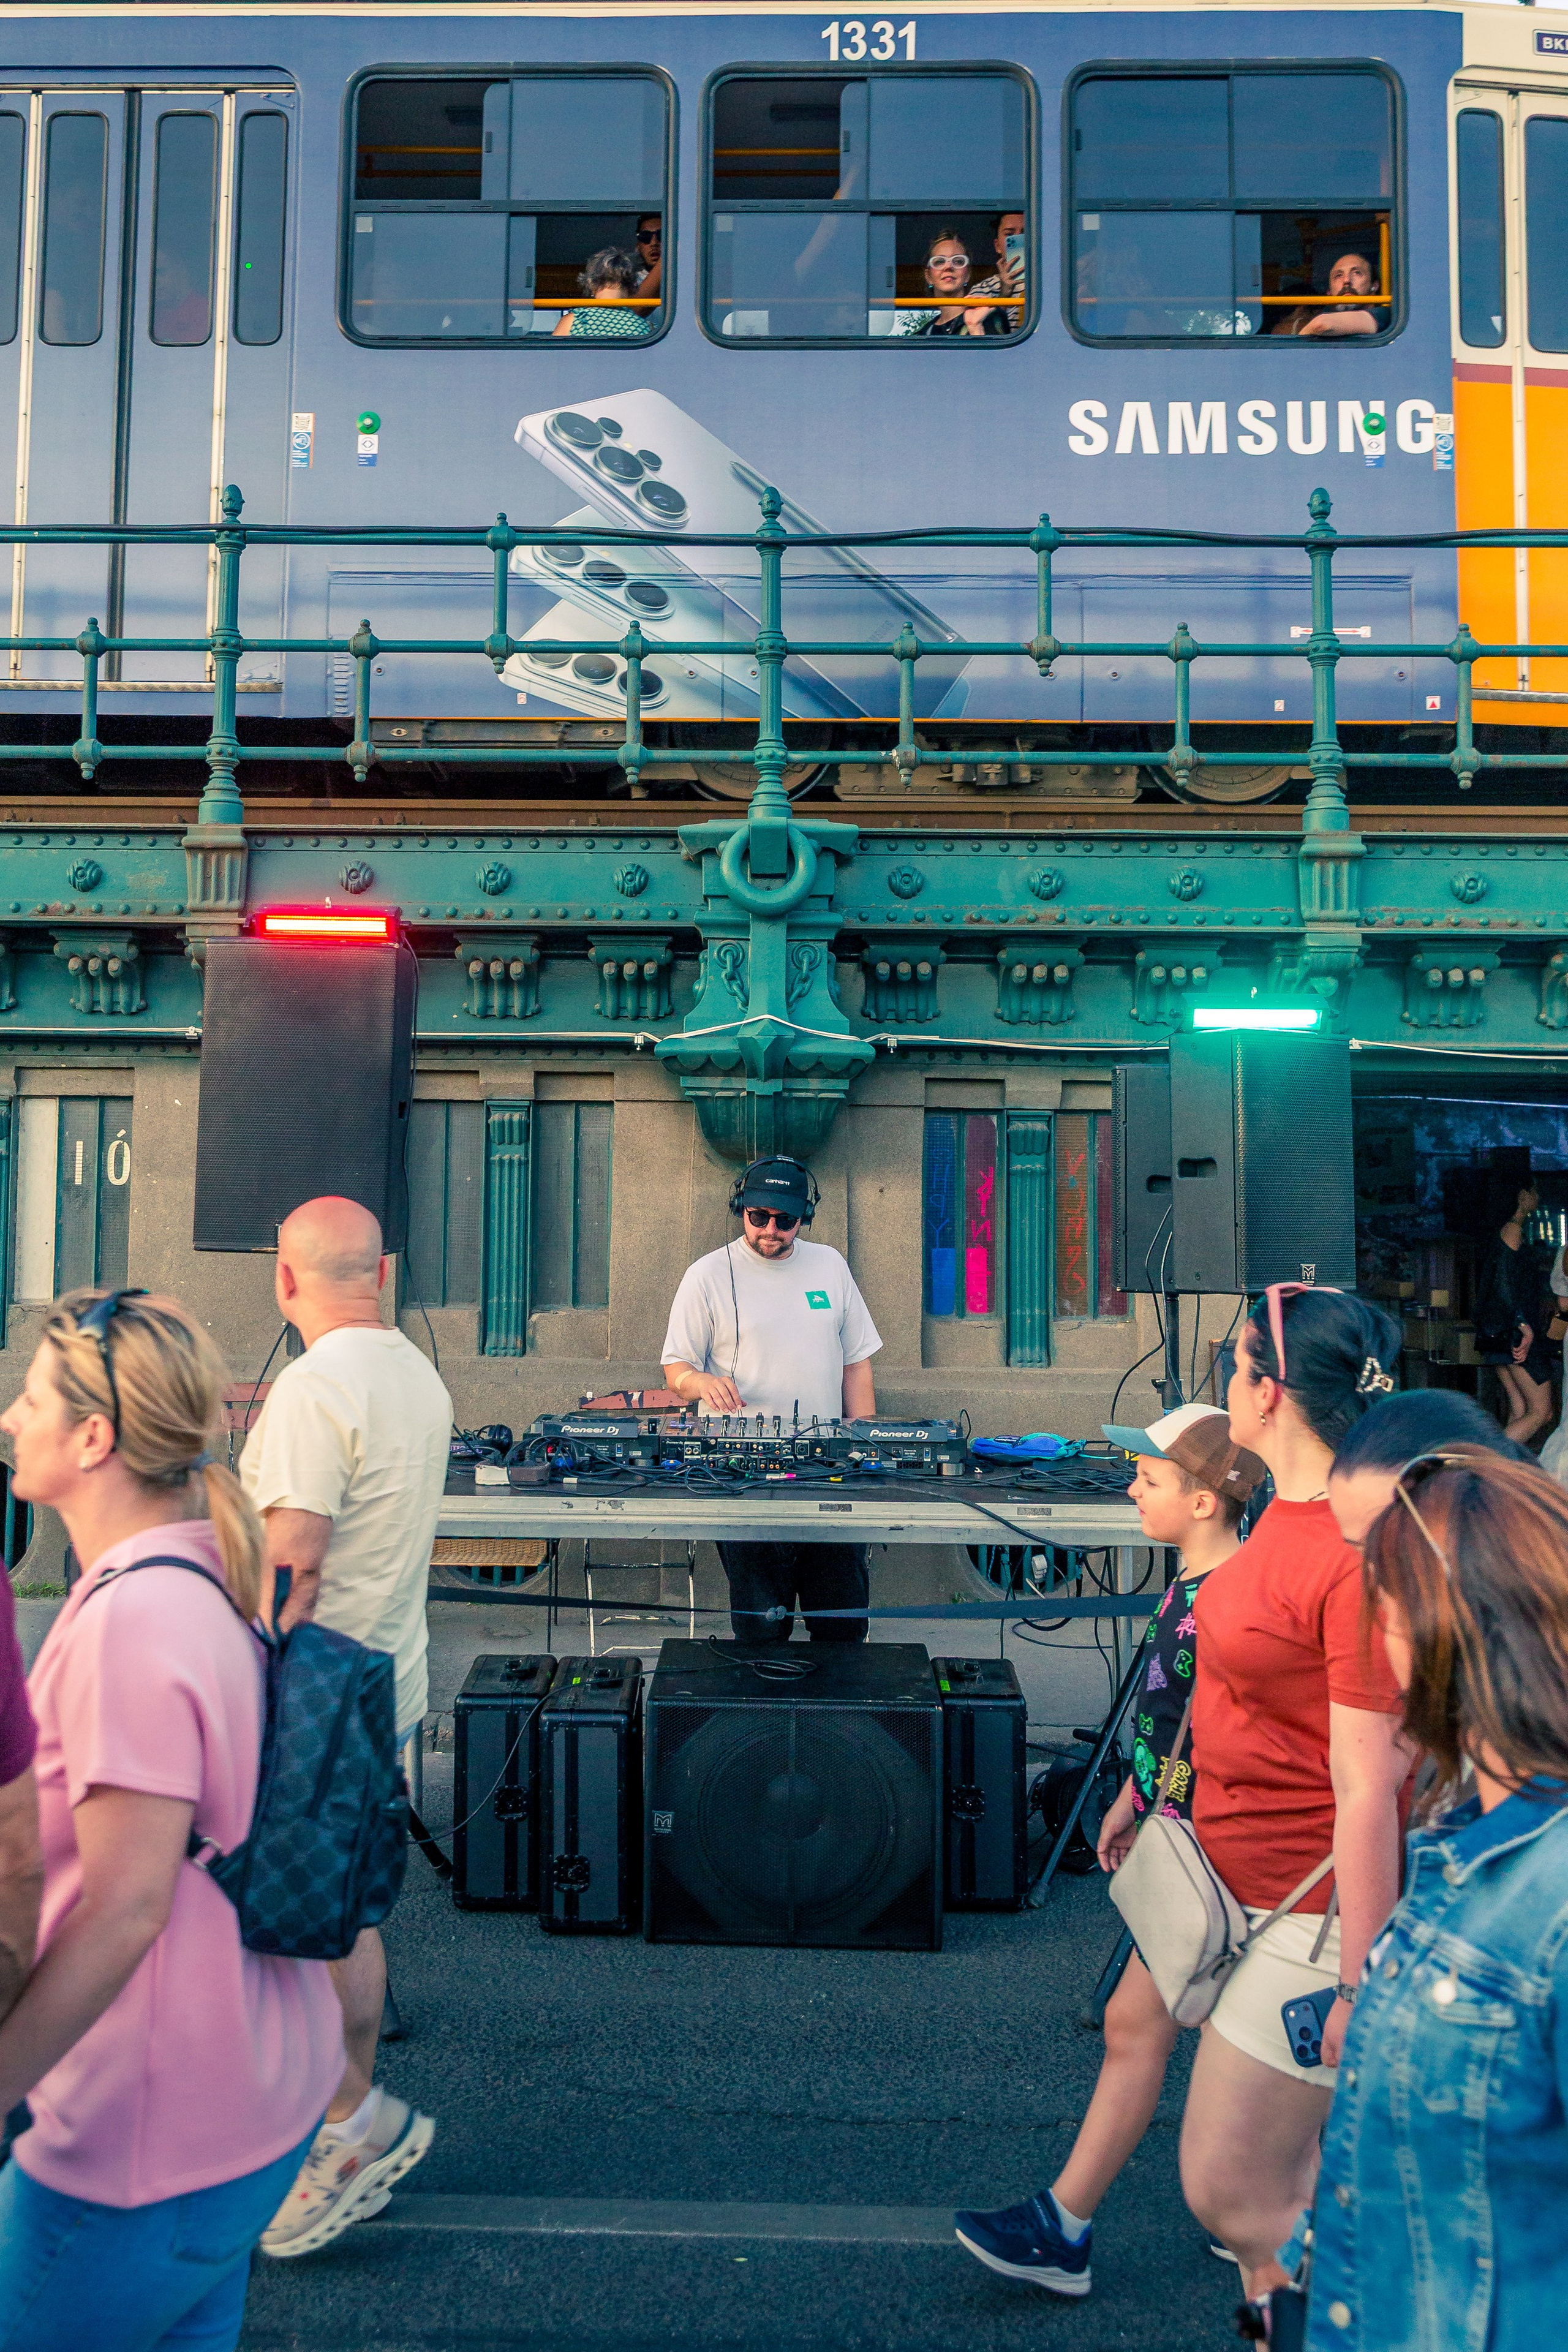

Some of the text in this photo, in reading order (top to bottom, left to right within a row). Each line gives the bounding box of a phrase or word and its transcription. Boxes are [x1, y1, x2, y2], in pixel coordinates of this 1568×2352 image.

[821, 20, 916, 61] 1331
[1542, 37, 1568, 50] BK
[1068, 399, 1436, 456] SAMSUNG
[1275, 701, 1283, 710] 2
[870, 1429, 914, 1438] Pioneer
